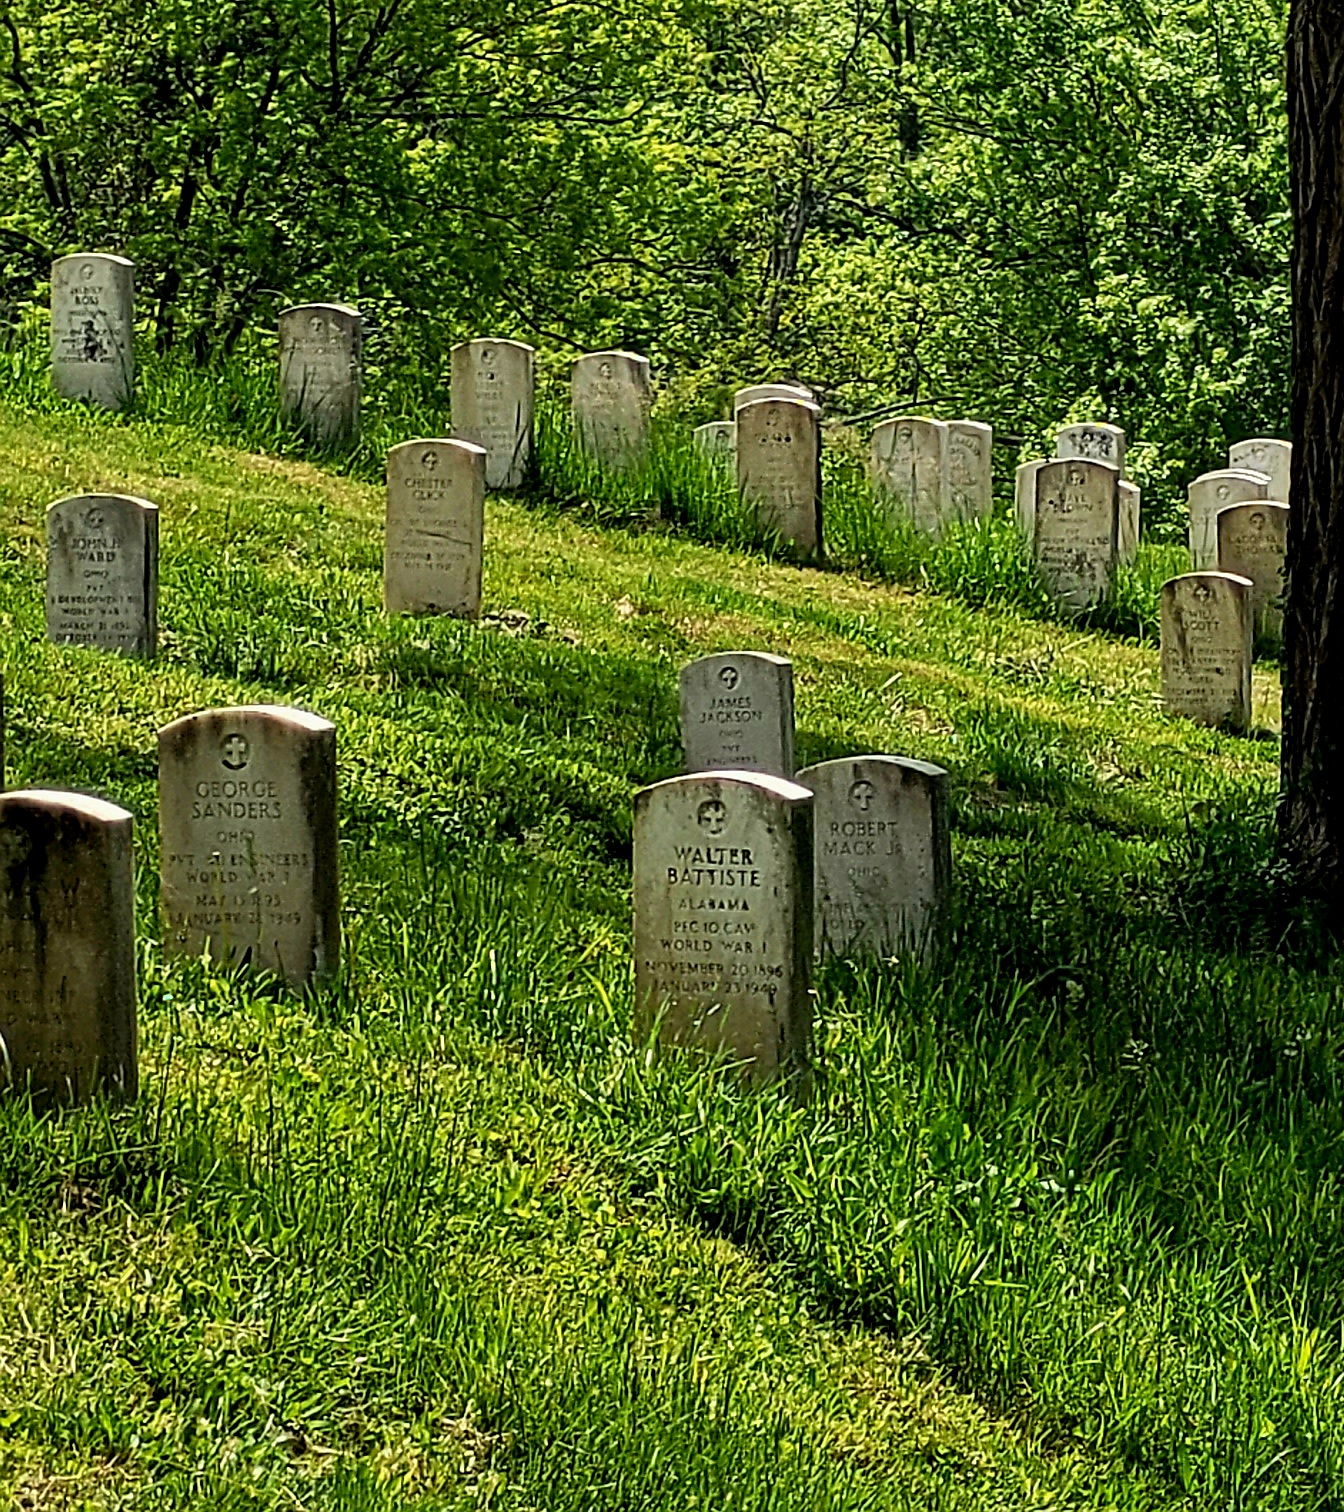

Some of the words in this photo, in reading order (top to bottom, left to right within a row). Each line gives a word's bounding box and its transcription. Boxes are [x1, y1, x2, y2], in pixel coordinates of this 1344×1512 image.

[699, 710, 763, 724] JACKSON
[195, 780, 279, 799] GEORGE
[191, 801, 283, 820] SANDERS
[830, 821, 899, 838] ROBERT
[674, 846, 754, 866] WALTER
[824, 841, 878, 856] MACK
[667, 867, 762, 887] BATTISTE
[678, 899, 751, 912] ALABAMA
[674, 921, 700, 934] PFC
[660, 938, 713, 952] WORLD
[721, 941, 753, 954] WAR
